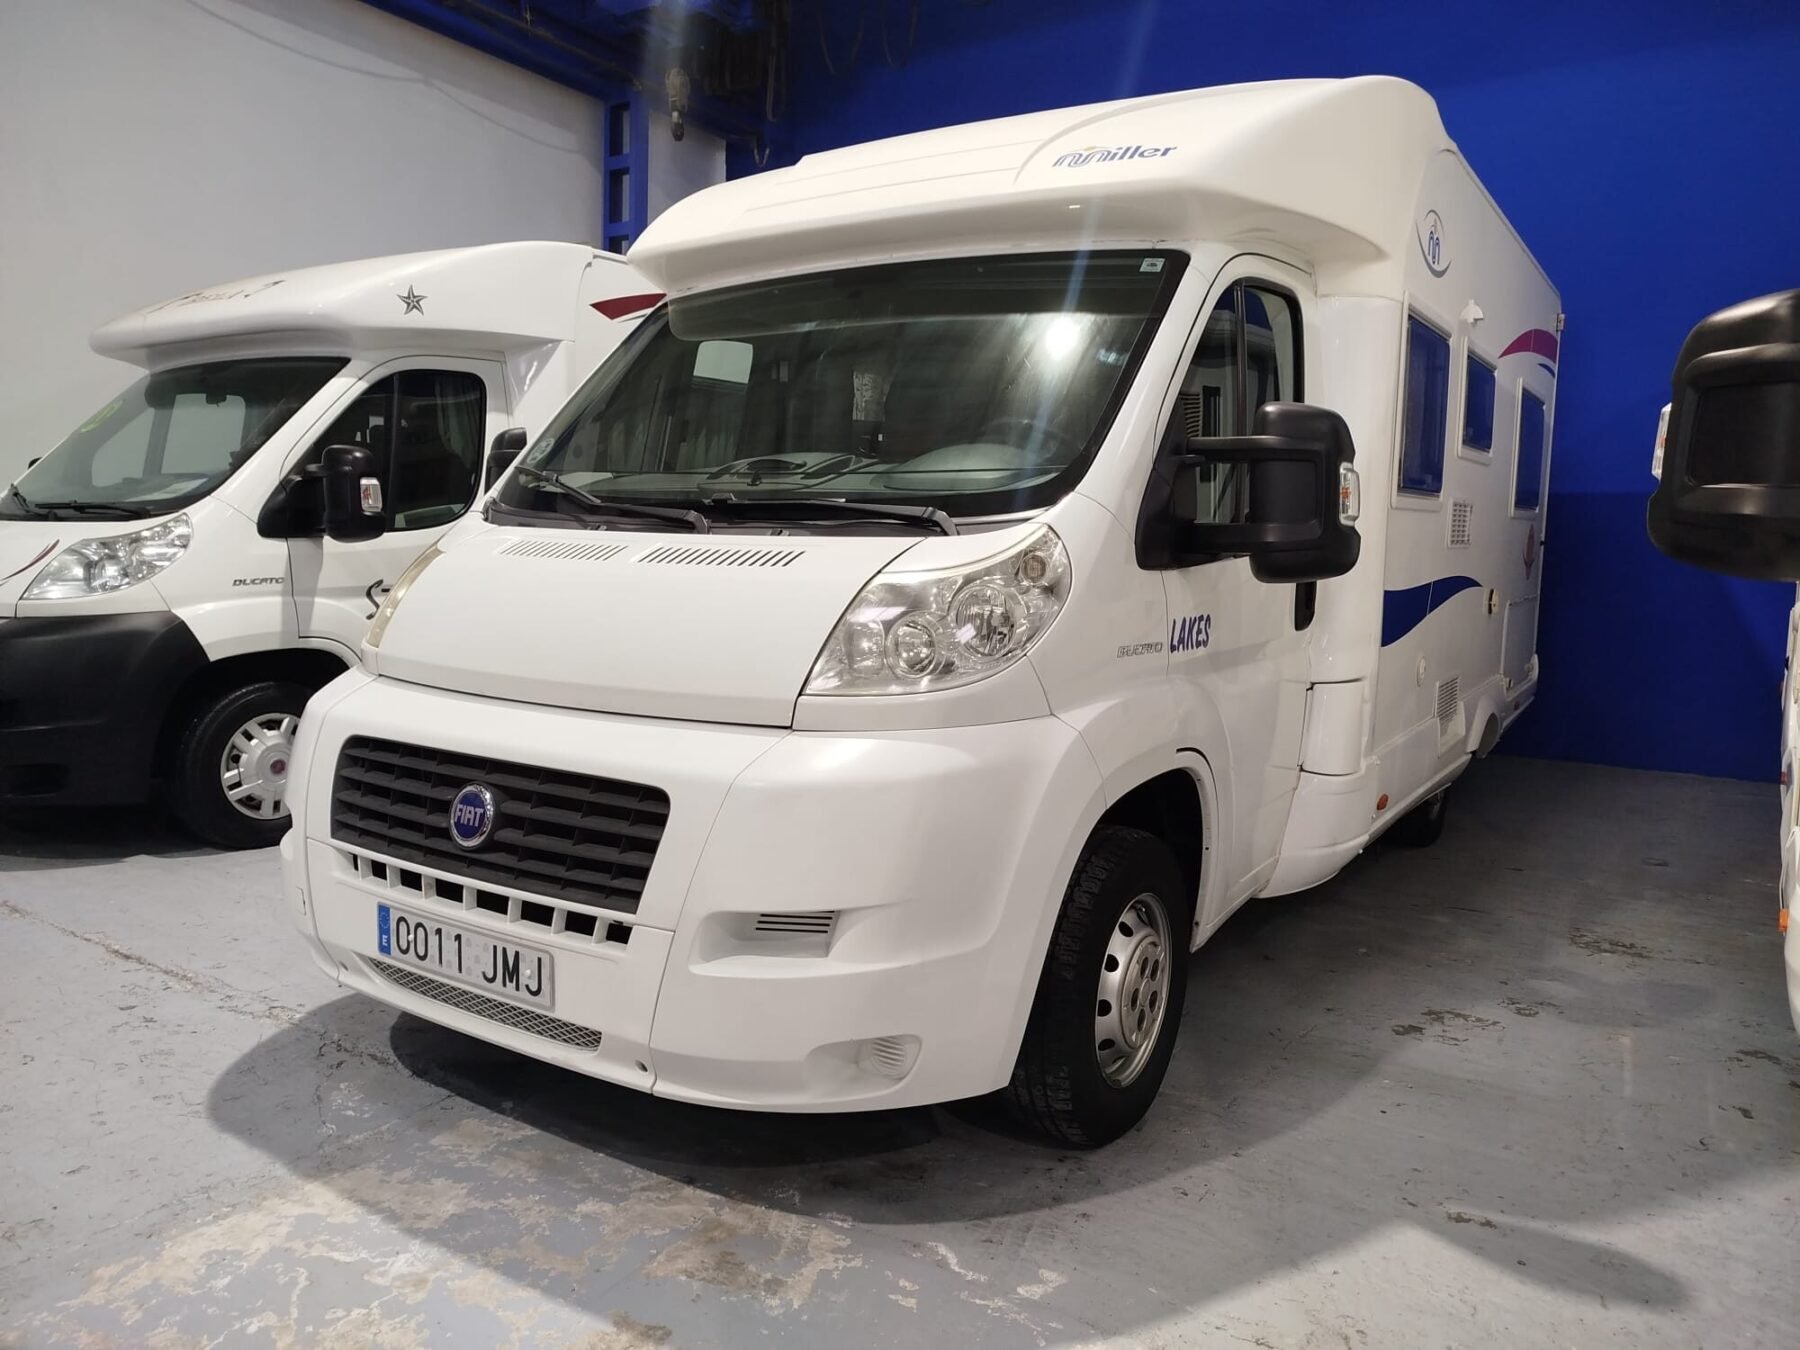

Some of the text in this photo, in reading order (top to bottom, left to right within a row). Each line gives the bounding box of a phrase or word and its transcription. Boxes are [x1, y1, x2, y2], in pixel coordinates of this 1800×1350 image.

[231, 577, 286, 587] DUCATO
[1169, 613, 1212, 654] LAKES
[455, 803, 485, 828] FIAT
[381, 934, 389, 947] E
[395, 915, 543, 997] 0011 JMJ
